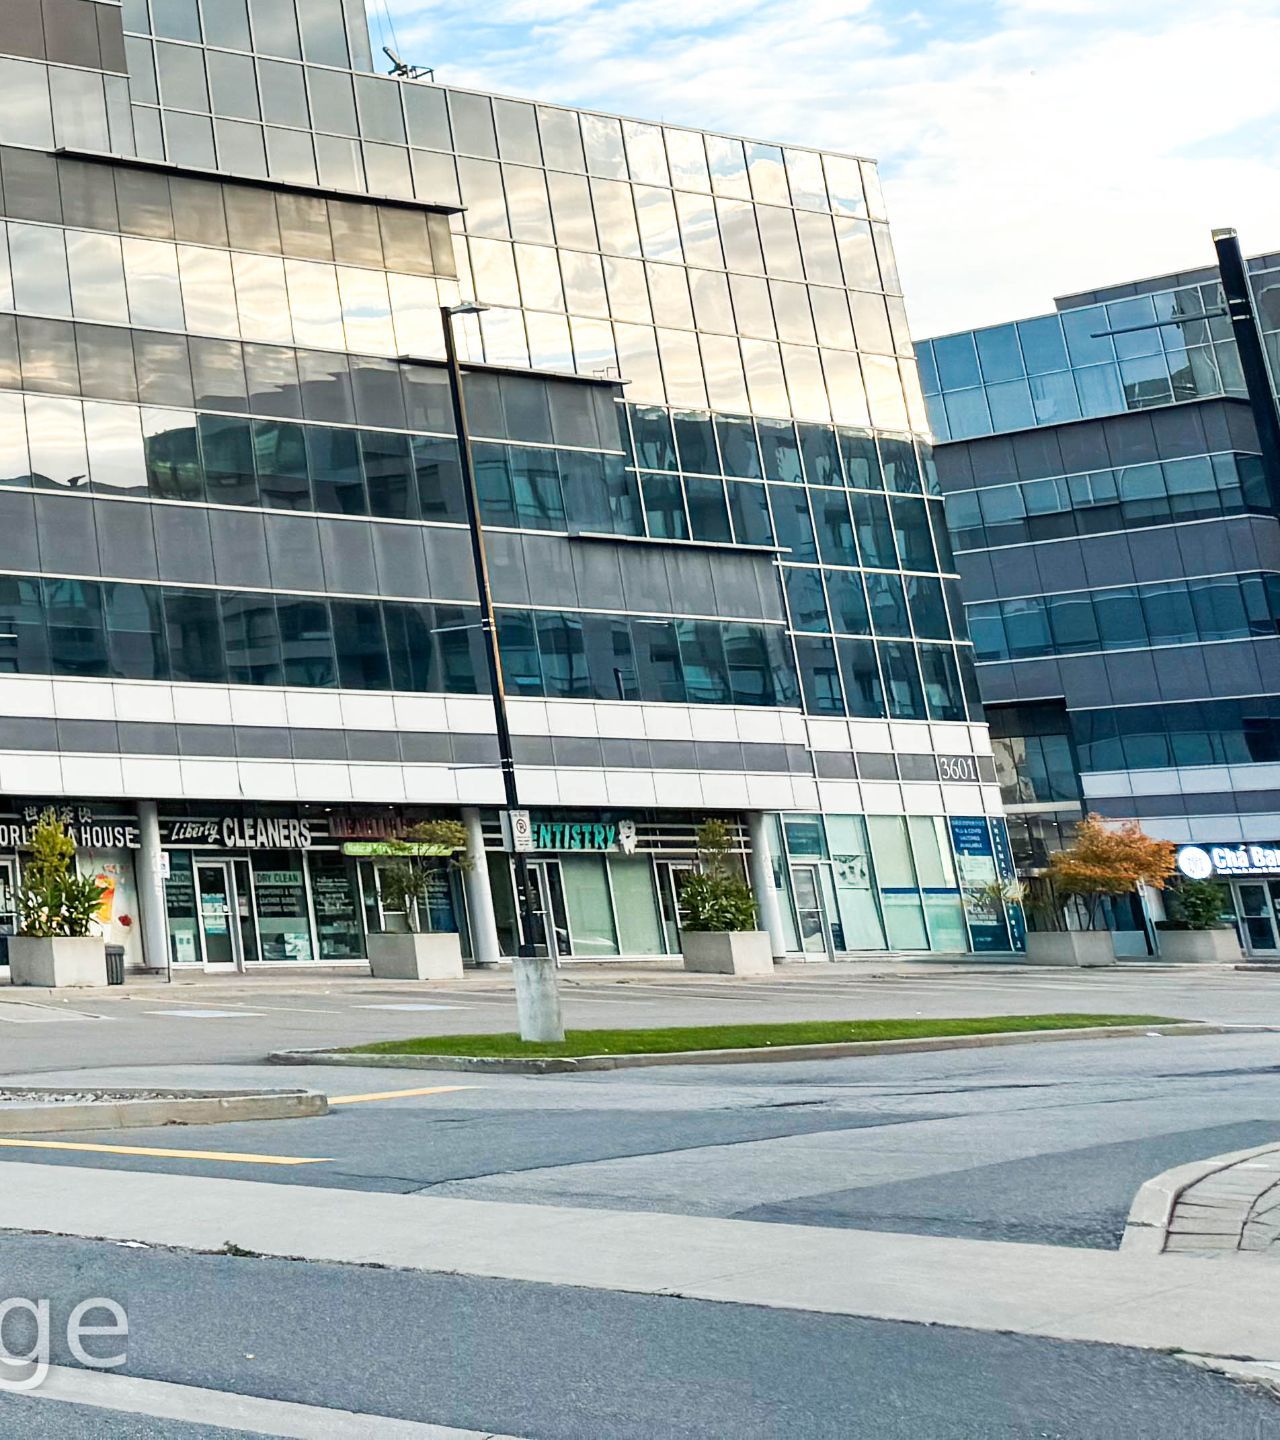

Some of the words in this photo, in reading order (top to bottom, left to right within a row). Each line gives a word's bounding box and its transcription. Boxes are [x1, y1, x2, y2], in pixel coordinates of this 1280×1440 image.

[940, 757, 977, 780] 3601
[81, 825, 135, 848] HOUSE
[172, 821, 220, 843] Liberty
[223, 817, 312, 848] CLEANERS
[531, 823, 615, 849] ENTISTRY
[1212, 844, 1249, 868] Chá
[256, 871, 271, 882] DRY
[274, 872, 299, 883] CLEAN
